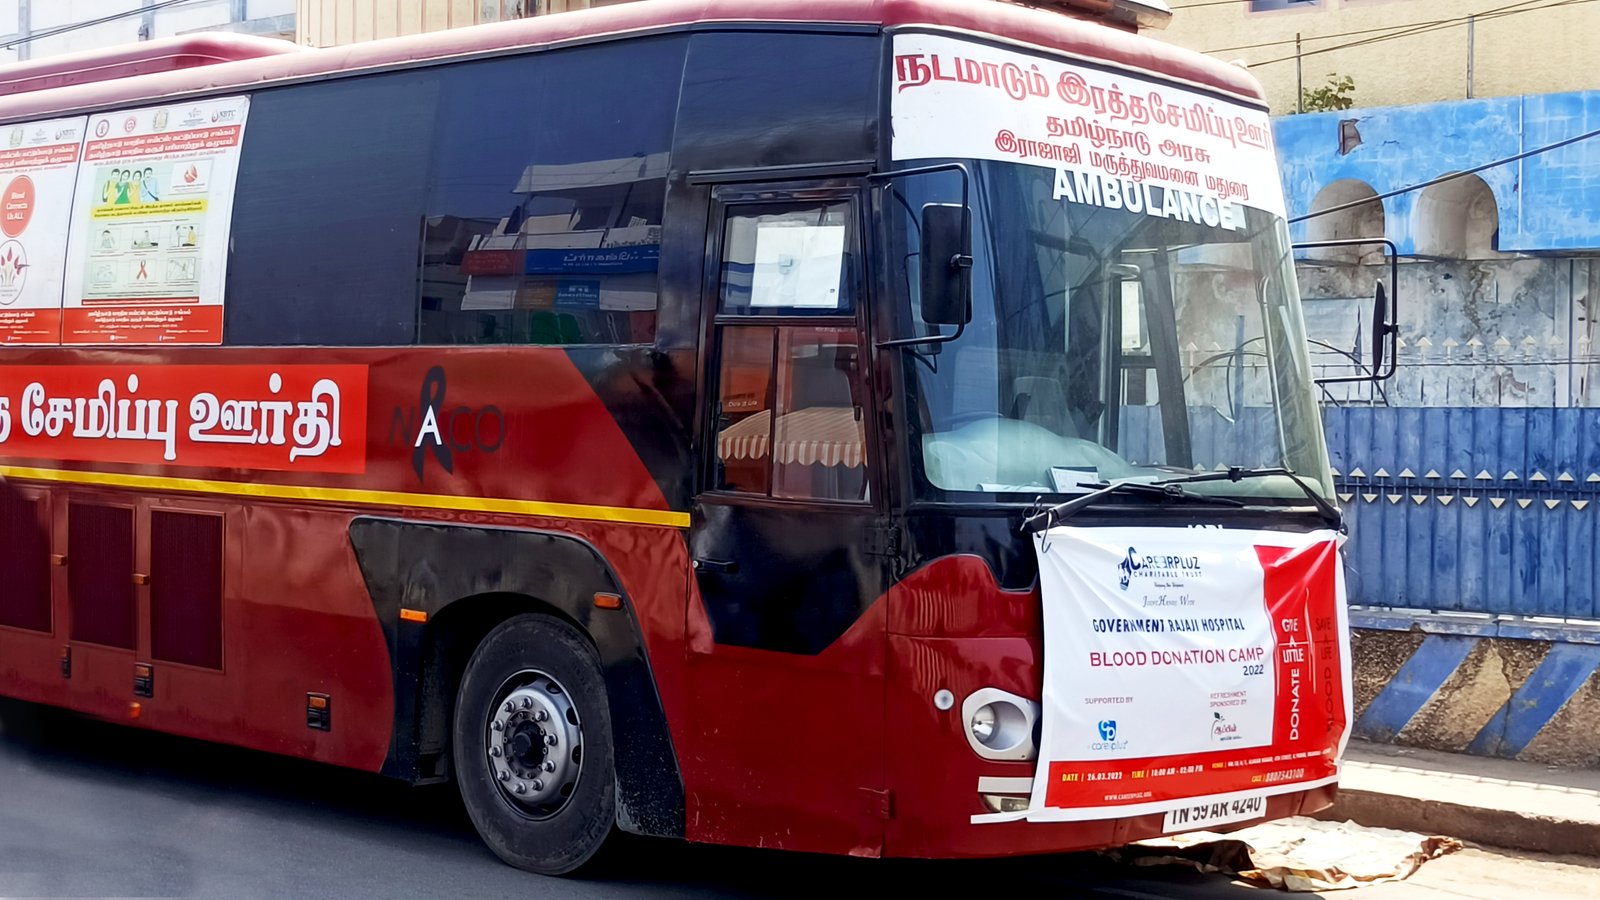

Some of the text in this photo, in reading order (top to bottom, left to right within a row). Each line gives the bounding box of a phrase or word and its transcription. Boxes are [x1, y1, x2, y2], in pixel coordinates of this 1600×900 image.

[895, 54, 1050, 101] நடமாடும்
[1046, 116, 1211, 164] தமிழ்நாடு அரசு
[995, 129, 1249, 201] இராஜாஜி மருத்துவமனை மதுரை
[1053, 168, 1237, 231] AMBULANCE
[21, 373, 178, 461] சேமிப்பு
[189, 372, 342, 462] ஊர்தி
[389, 403, 505, 454] NACO
[1093, 617, 1246, 633] GOVERNMENT RAJAJI HOSPITAL
[1090, 647, 1265, 667] BLOOD DONATION CAMP
[1243, 664, 1265, 676] 2022
[1084, 696, 1134, 705] SUPPORTED BY
[1289, 668, 1300, 741] DONATE
[1062, 773, 1079, 782] DATE
[1131, 770, 1145, 779] TIME
[1192, 805, 1209, 821] 59
[1210, 801, 1229, 819] AR
[1231, 797, 1262, 815] 4240
